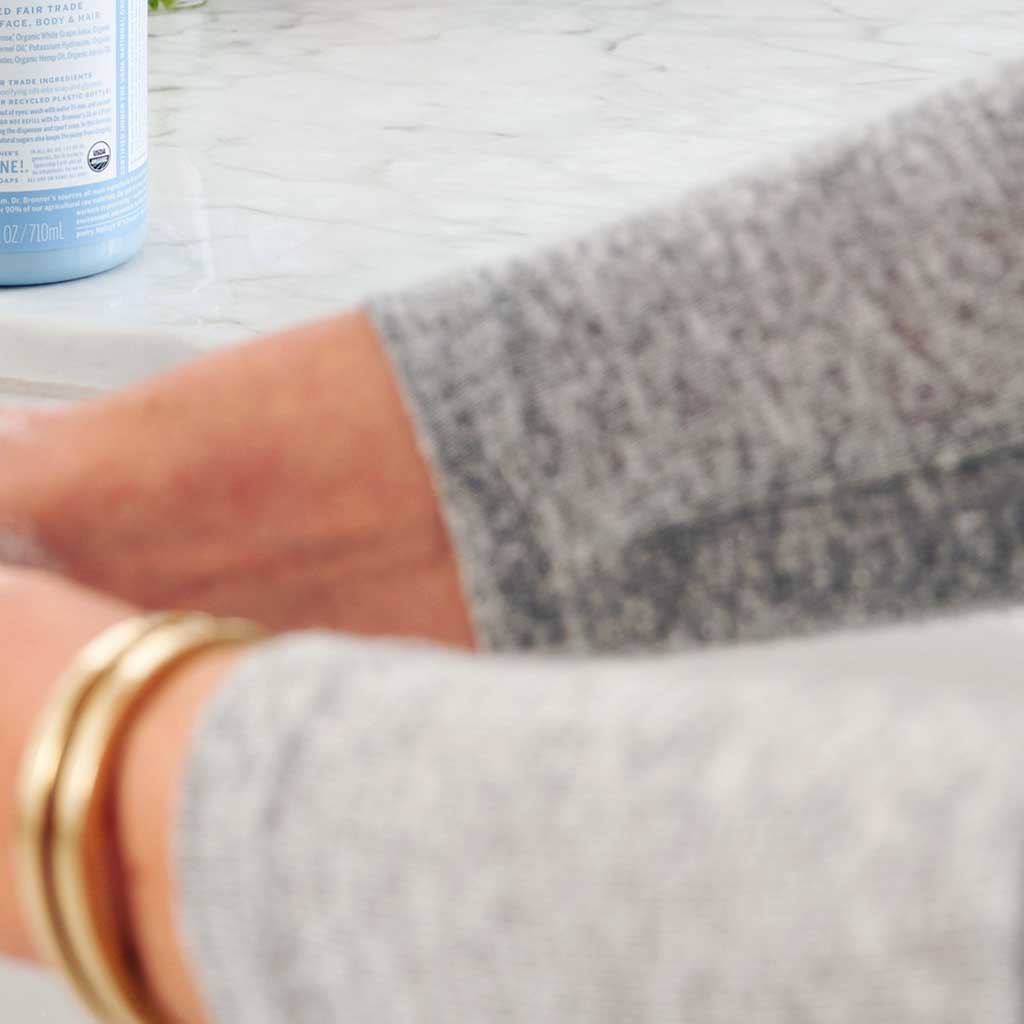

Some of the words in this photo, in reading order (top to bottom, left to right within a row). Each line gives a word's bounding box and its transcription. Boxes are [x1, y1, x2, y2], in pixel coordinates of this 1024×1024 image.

[16, 6, 43, 16] FAIR
[48, 1, 83, 13] TRADE
[36, 16, 64, 26] BODY
[68, 15, 75, 24] &
[9, 78, 36, 86] TRADE
[3, 224, 19, 244] OZ
[29, 221, 65, 243] 710mL
